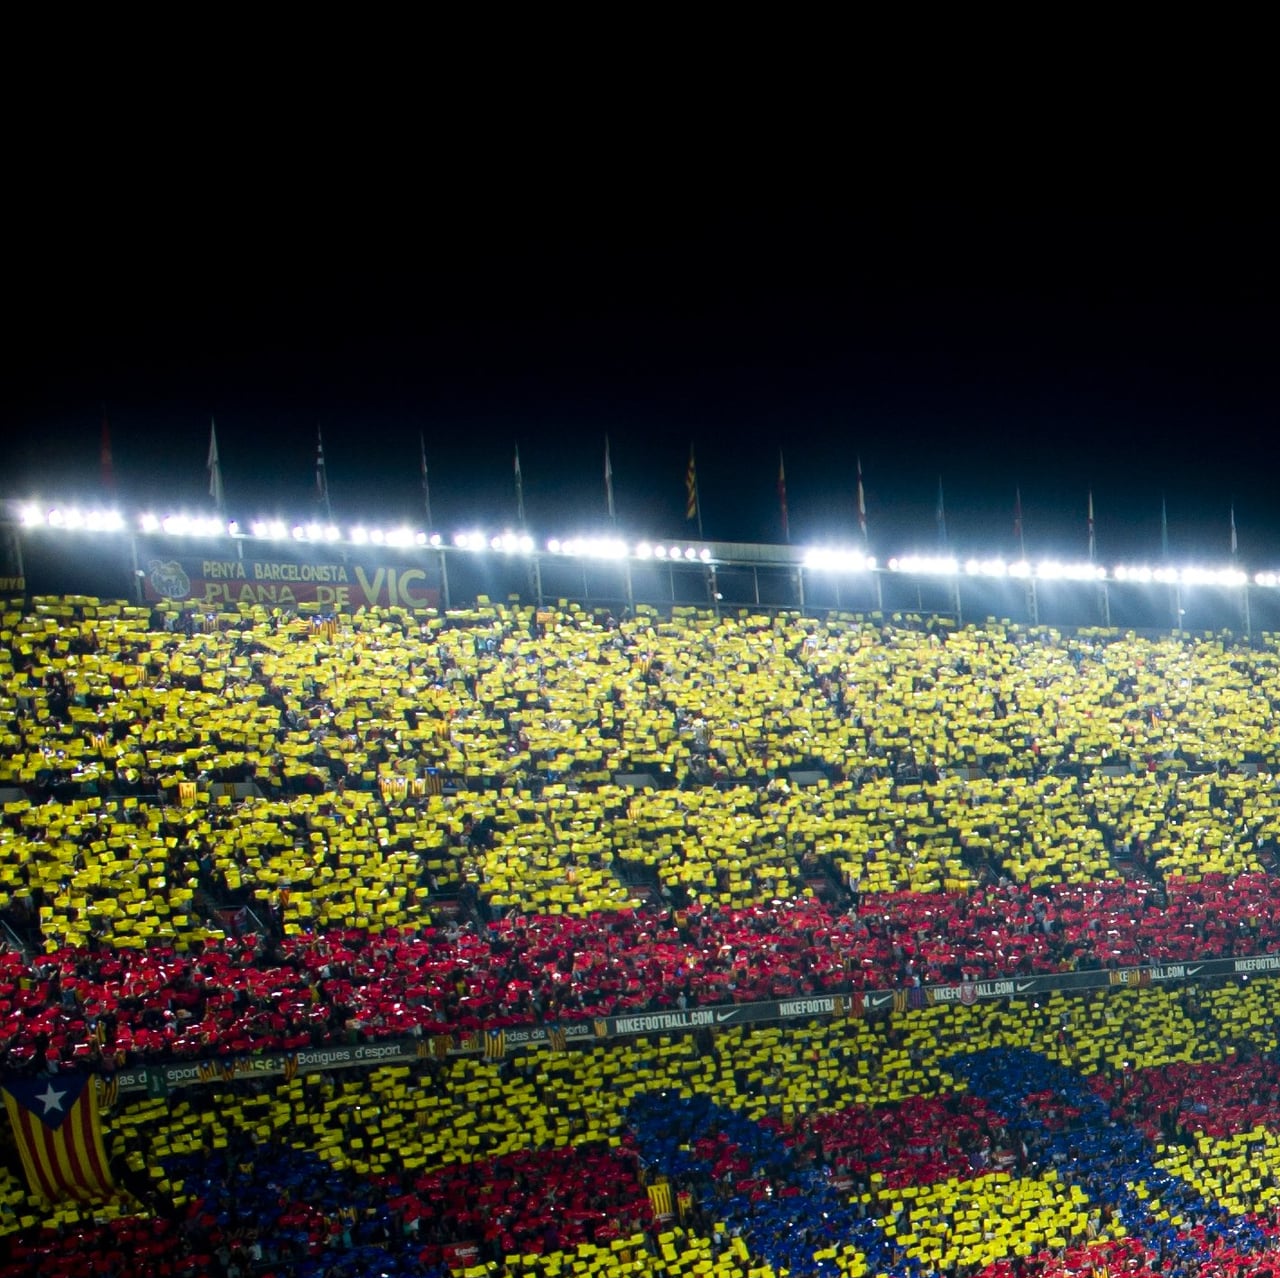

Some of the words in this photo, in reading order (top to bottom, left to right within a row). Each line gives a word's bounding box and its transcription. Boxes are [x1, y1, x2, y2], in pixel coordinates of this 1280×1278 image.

[203, 560, 246, 579] PENYA
[254, 563, 348, 583] BARCELONISTA
[203, 584, 298, 603] PLANA
[317, 586, 349, 605] DE
[354, 565, 427, 607] VIC
[616, 1010, 714, 1034] NIKEFOOTBALL.COM
[297, 1050, 350, 1067] Botigues
[354, 1043, 401, 1059] d'esport
